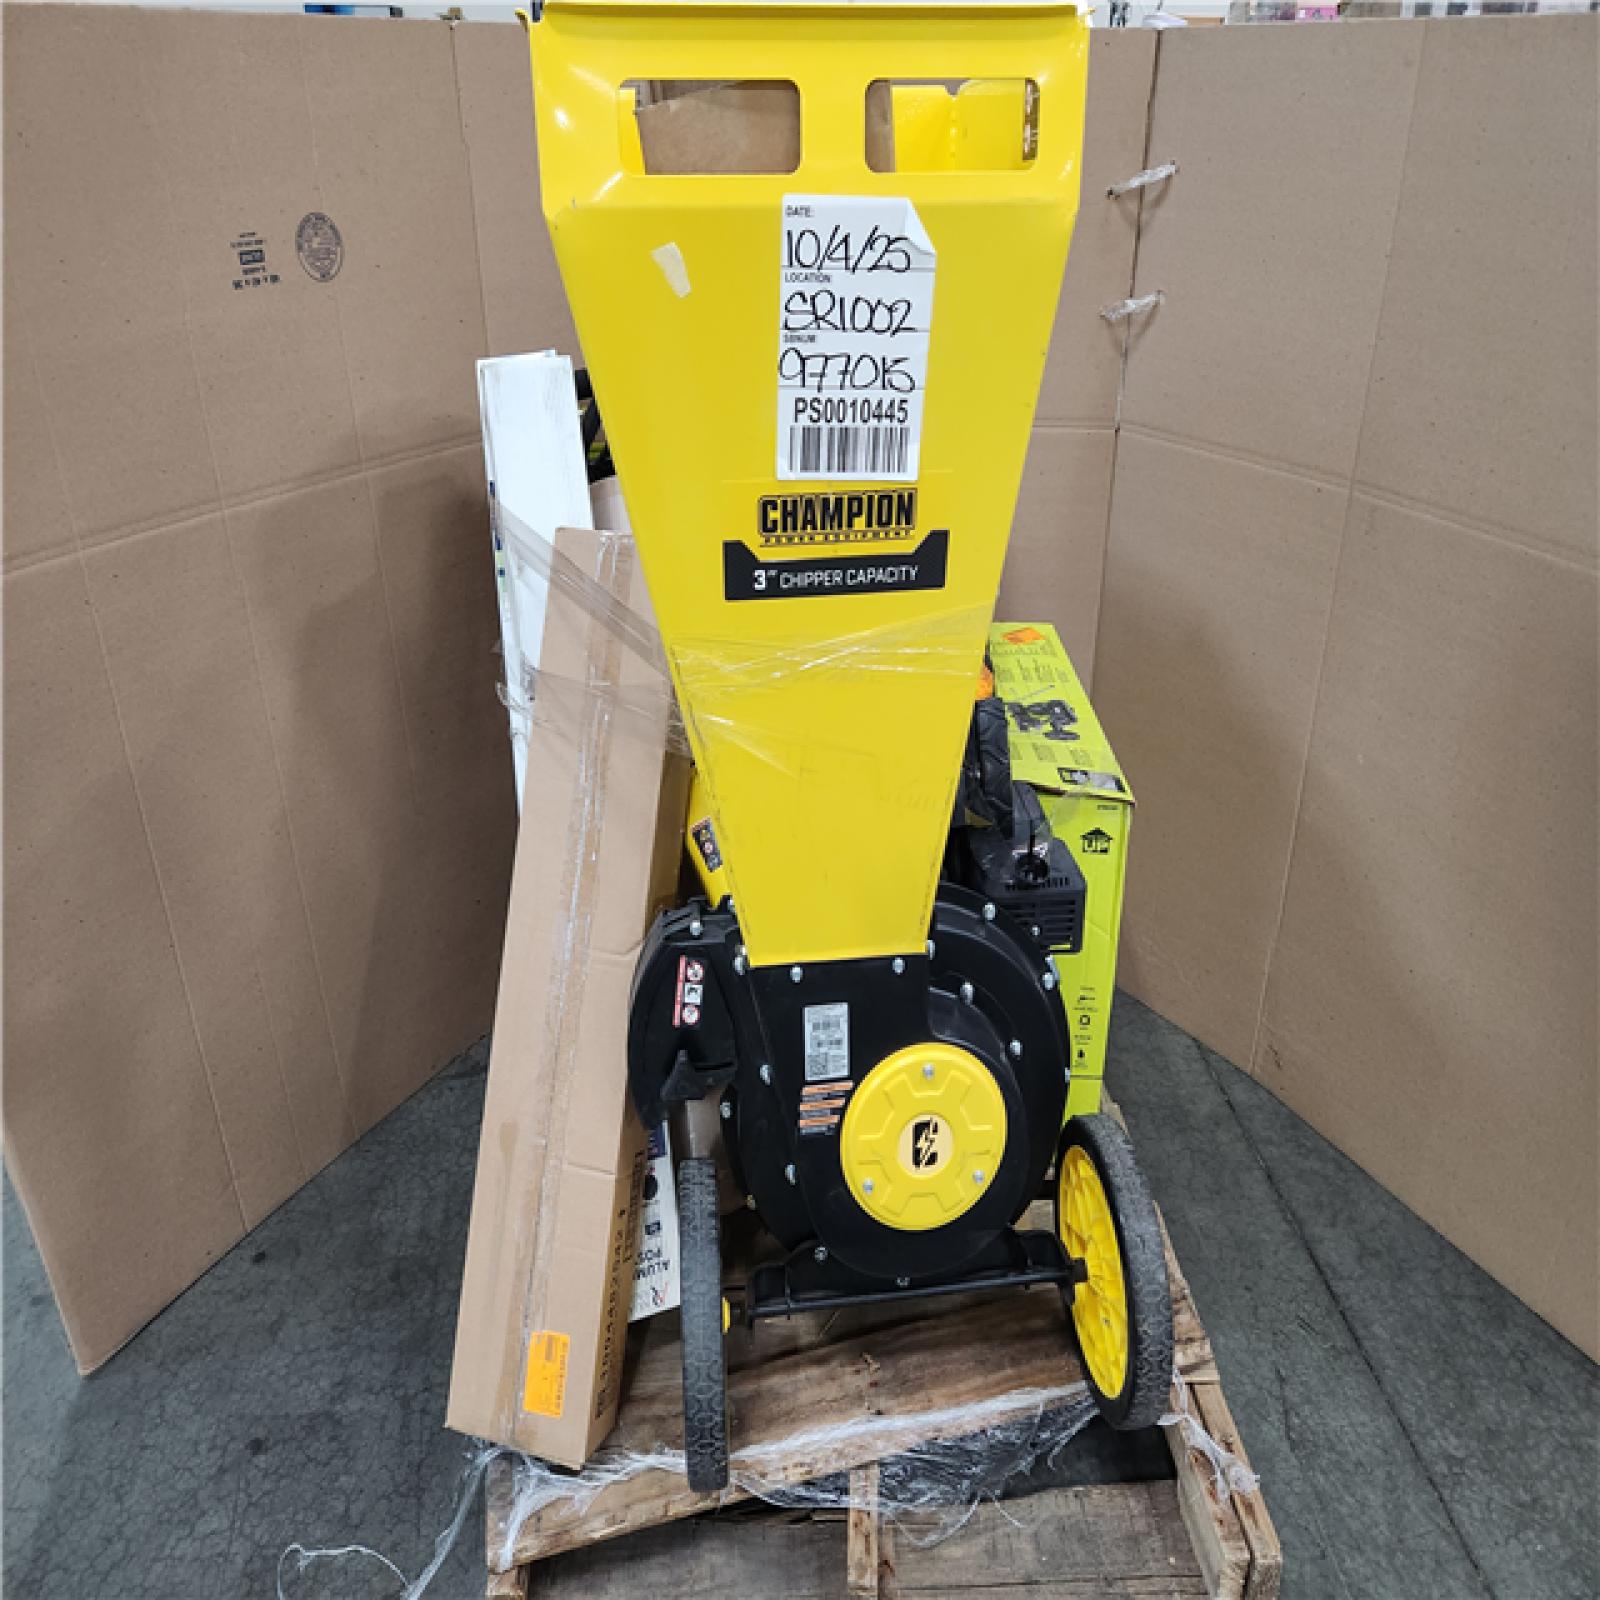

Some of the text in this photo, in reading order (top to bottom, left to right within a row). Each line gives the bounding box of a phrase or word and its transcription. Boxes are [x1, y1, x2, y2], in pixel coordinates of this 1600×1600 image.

[784, 289, 917, 337] SR1002
[794, 396, 908, 423] PS0010445
[759, 489, 917, 534] CHAMPION
[779, 569, 843, 589] CHIPPER
[847, 564, 919, 586] CAPACITY
